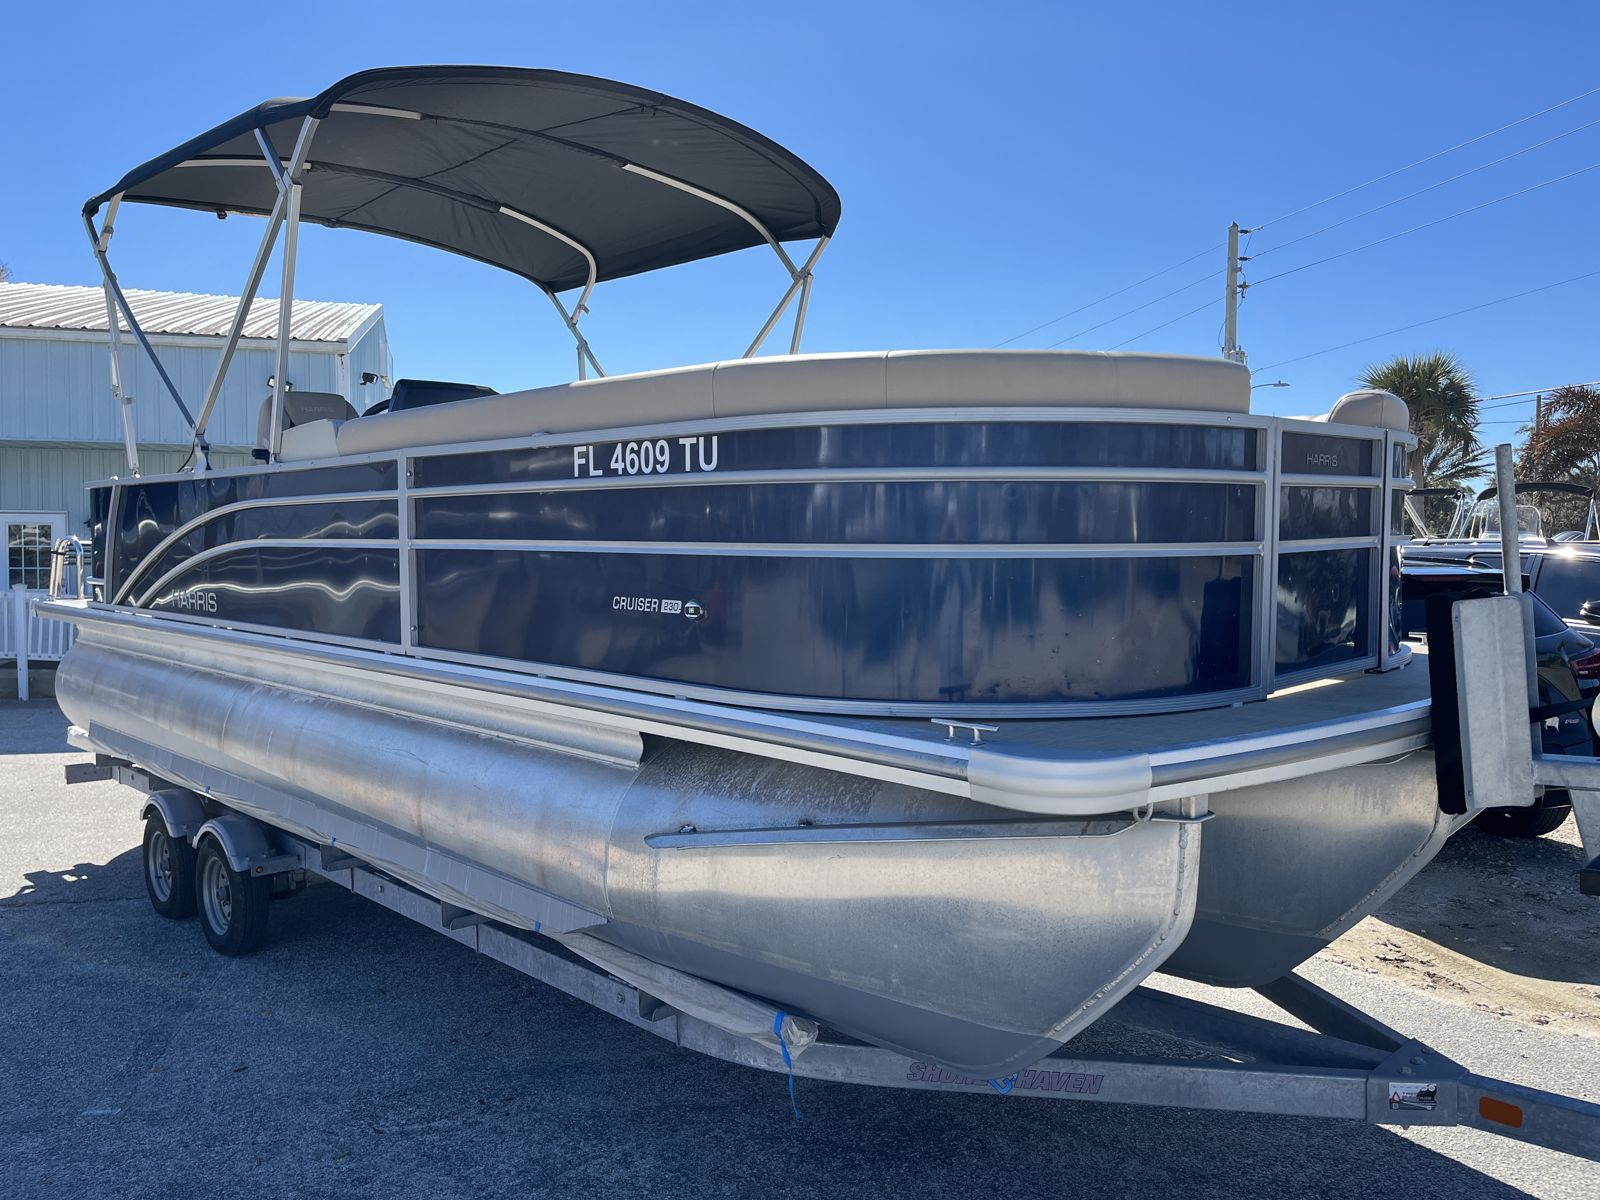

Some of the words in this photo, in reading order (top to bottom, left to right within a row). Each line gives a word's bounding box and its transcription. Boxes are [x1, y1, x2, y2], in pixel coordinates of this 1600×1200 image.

[573, 445, 603, 477] FL
[610, 440, 670, 475] 4609
[679, 435, 718, 472] TU
[1306, 452, 1338, 467] HARRIS
[172, 588, 217, 613] HARRIS
[612, 596, 659, 612] CRUISER
[663, 600, 679, 612] 230
[1014, 1069, 1104, 1094] HAVEN
